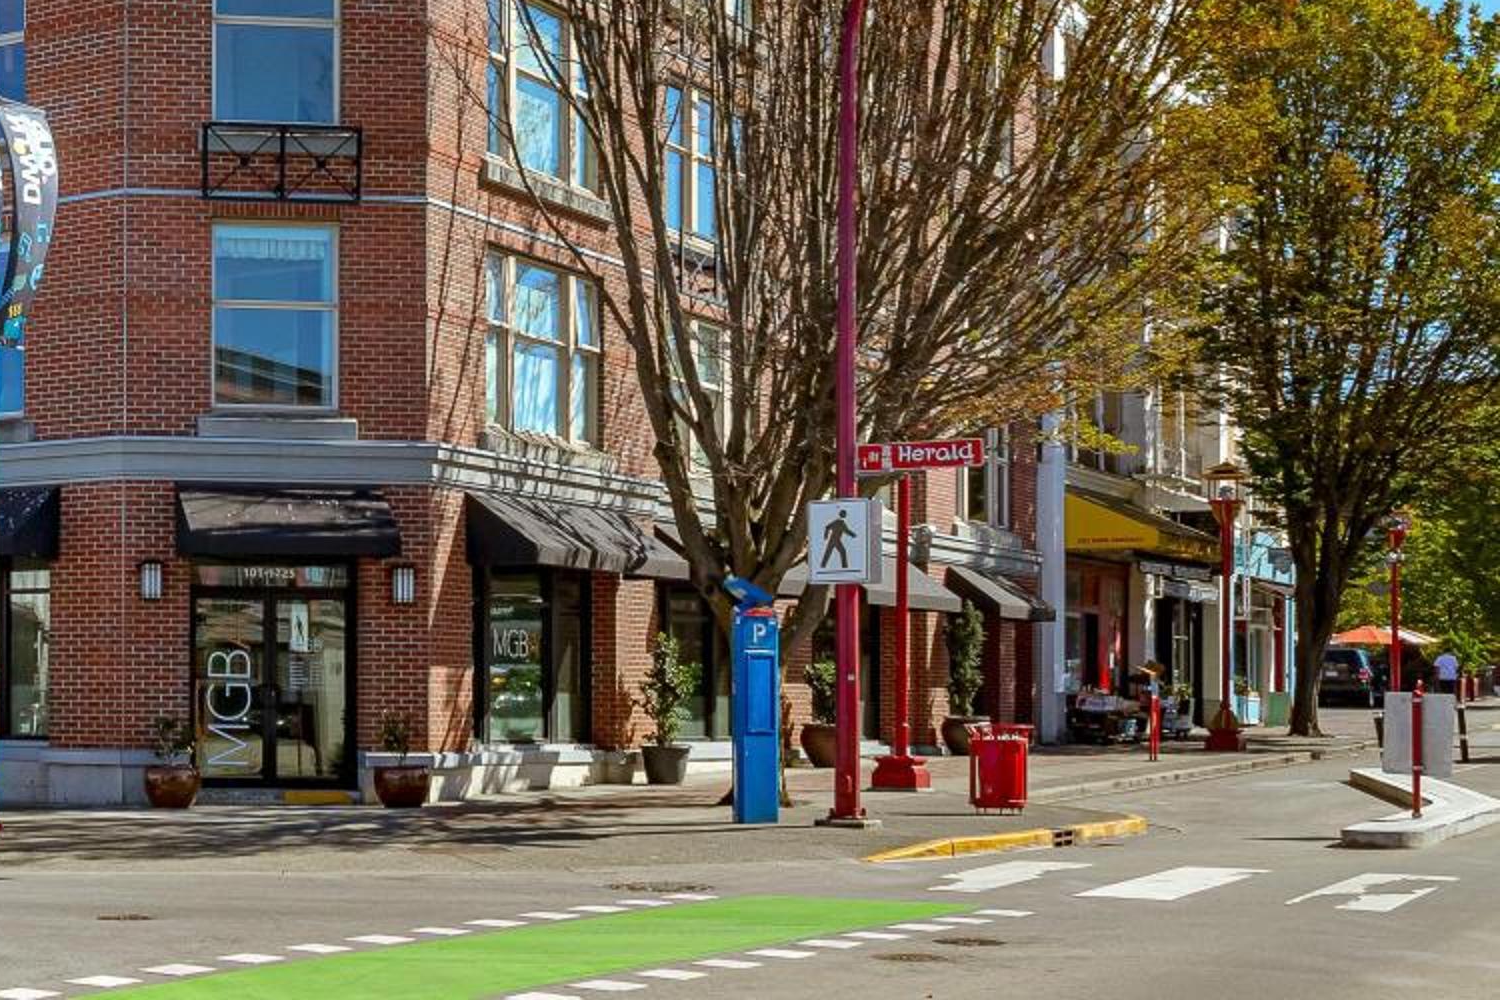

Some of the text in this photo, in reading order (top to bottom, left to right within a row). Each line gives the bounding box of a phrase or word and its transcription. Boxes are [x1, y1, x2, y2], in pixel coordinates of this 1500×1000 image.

[899, 443, 974, 463] Herald
[493, 627, 529, 659] MGB
[753, 623, 767, 643] P
[206, 650, 251, 766] MGB
